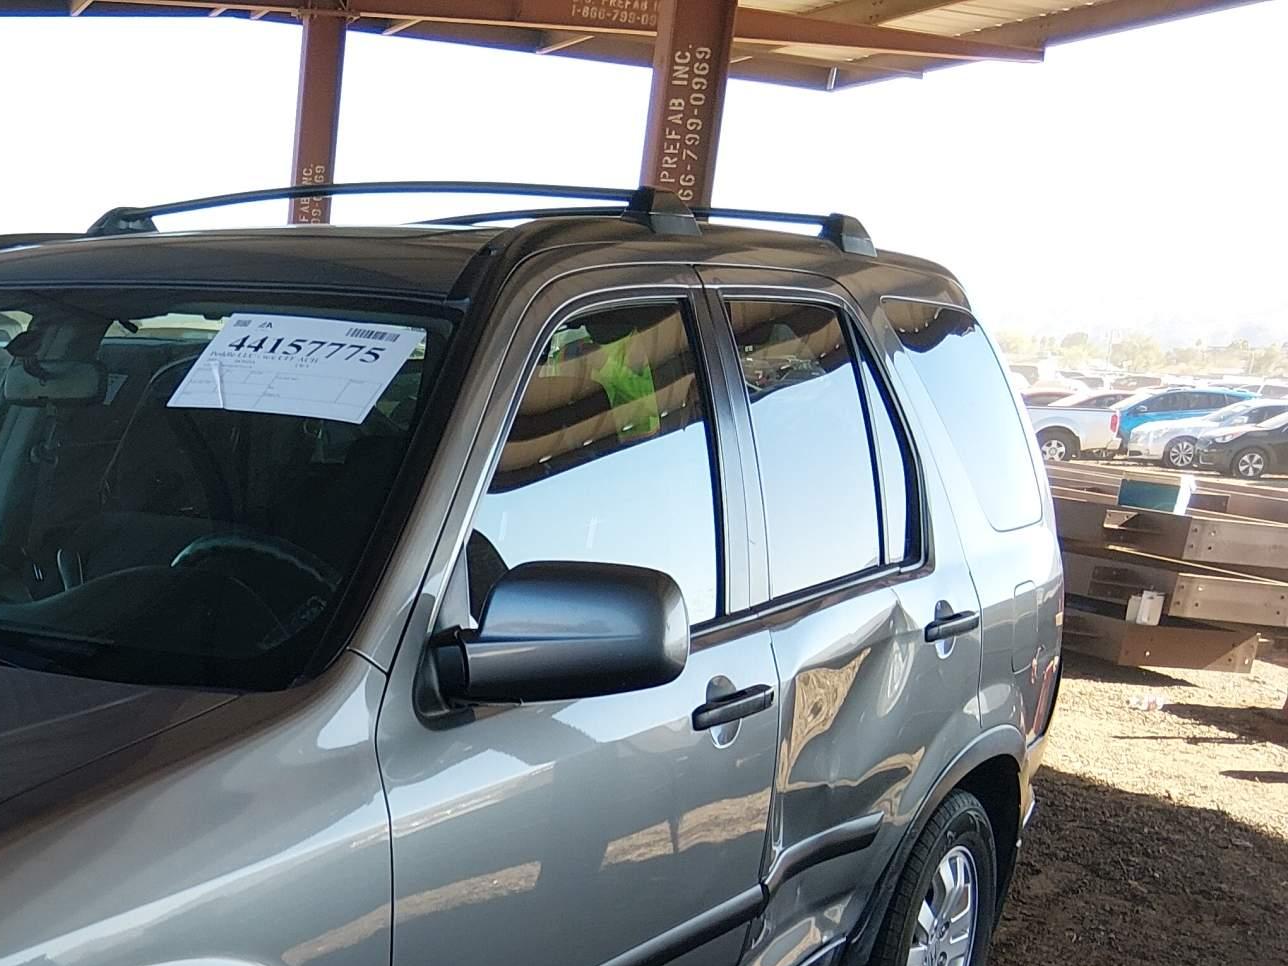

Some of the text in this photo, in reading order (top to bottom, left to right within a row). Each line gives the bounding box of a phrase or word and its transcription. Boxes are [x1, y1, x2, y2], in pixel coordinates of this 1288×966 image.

[660, 44, 693, 183] PREFAB INC.
[678, 47, 712, 201] 66-799-0969
[228, 334, 388, 364] 44157775
